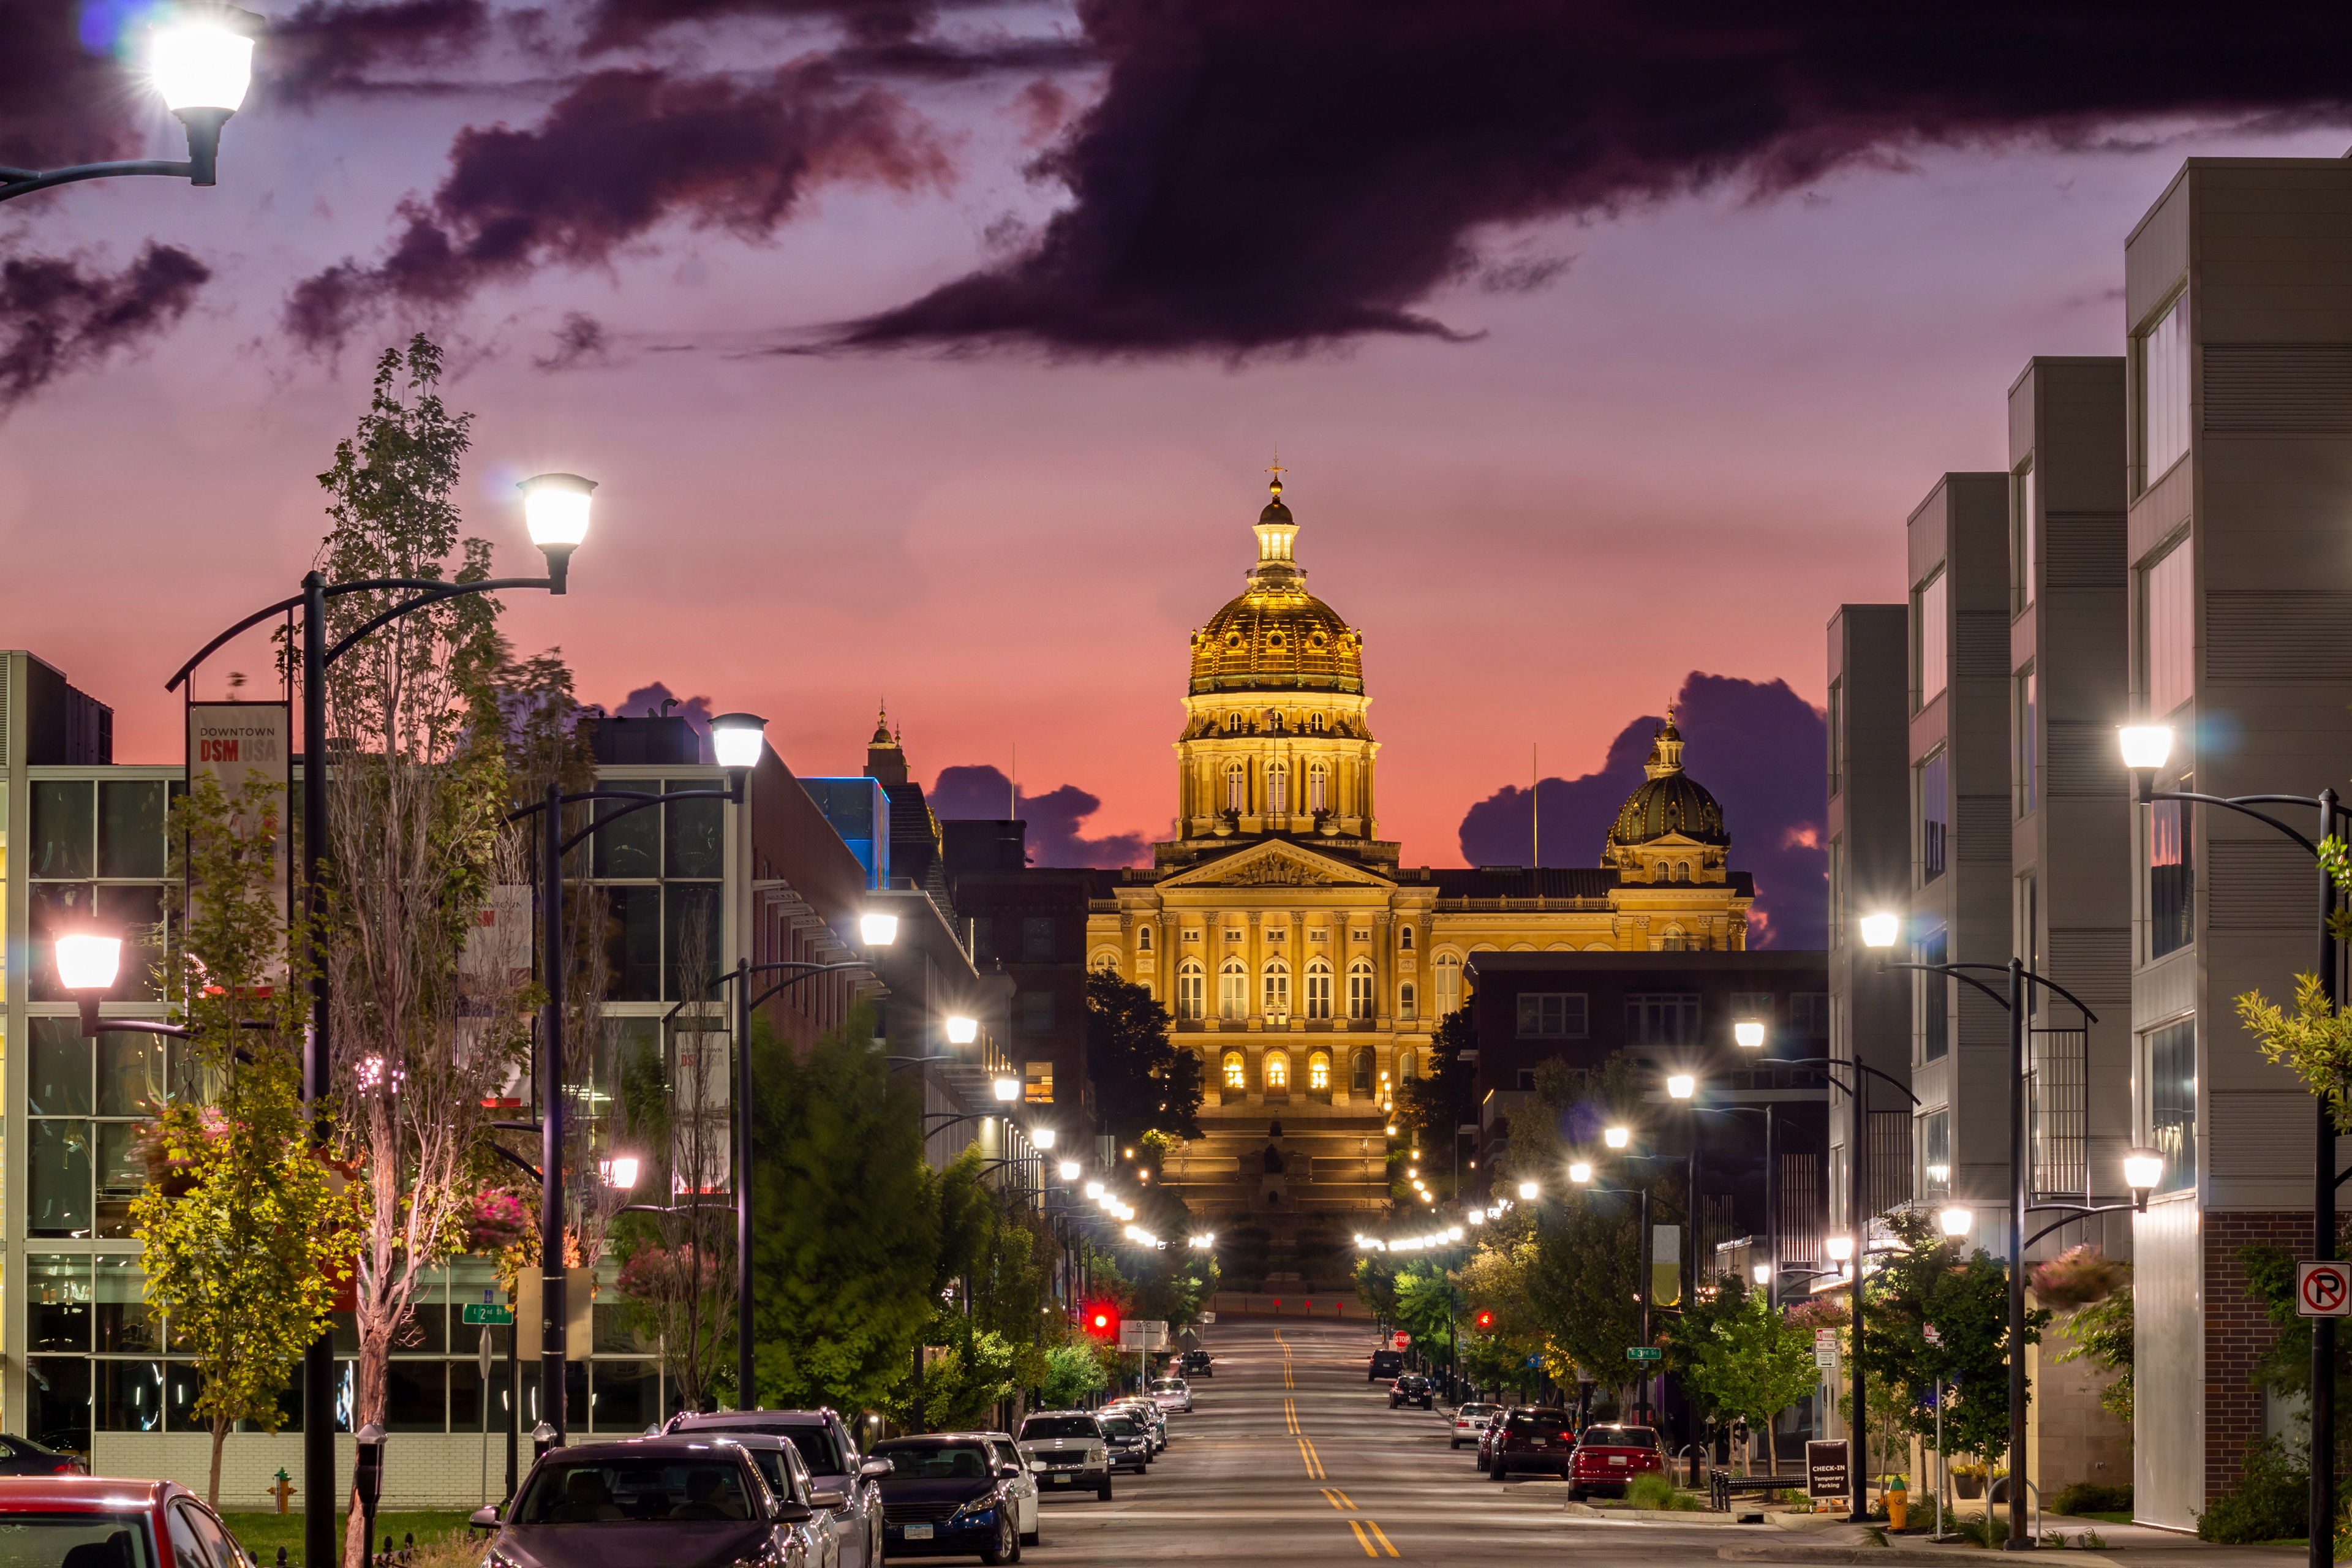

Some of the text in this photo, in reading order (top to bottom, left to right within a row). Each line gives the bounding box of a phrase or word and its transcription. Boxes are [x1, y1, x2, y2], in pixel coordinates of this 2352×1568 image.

[200, 728, 275, 736] DOWNTOWN
[200, 739, 277, 762] DSM USA
[480, 1308, 492, 1320] 2nd
[1924, 1325, 1932, 1335] NO
[1817, 1331, 1823, 1340] NO
